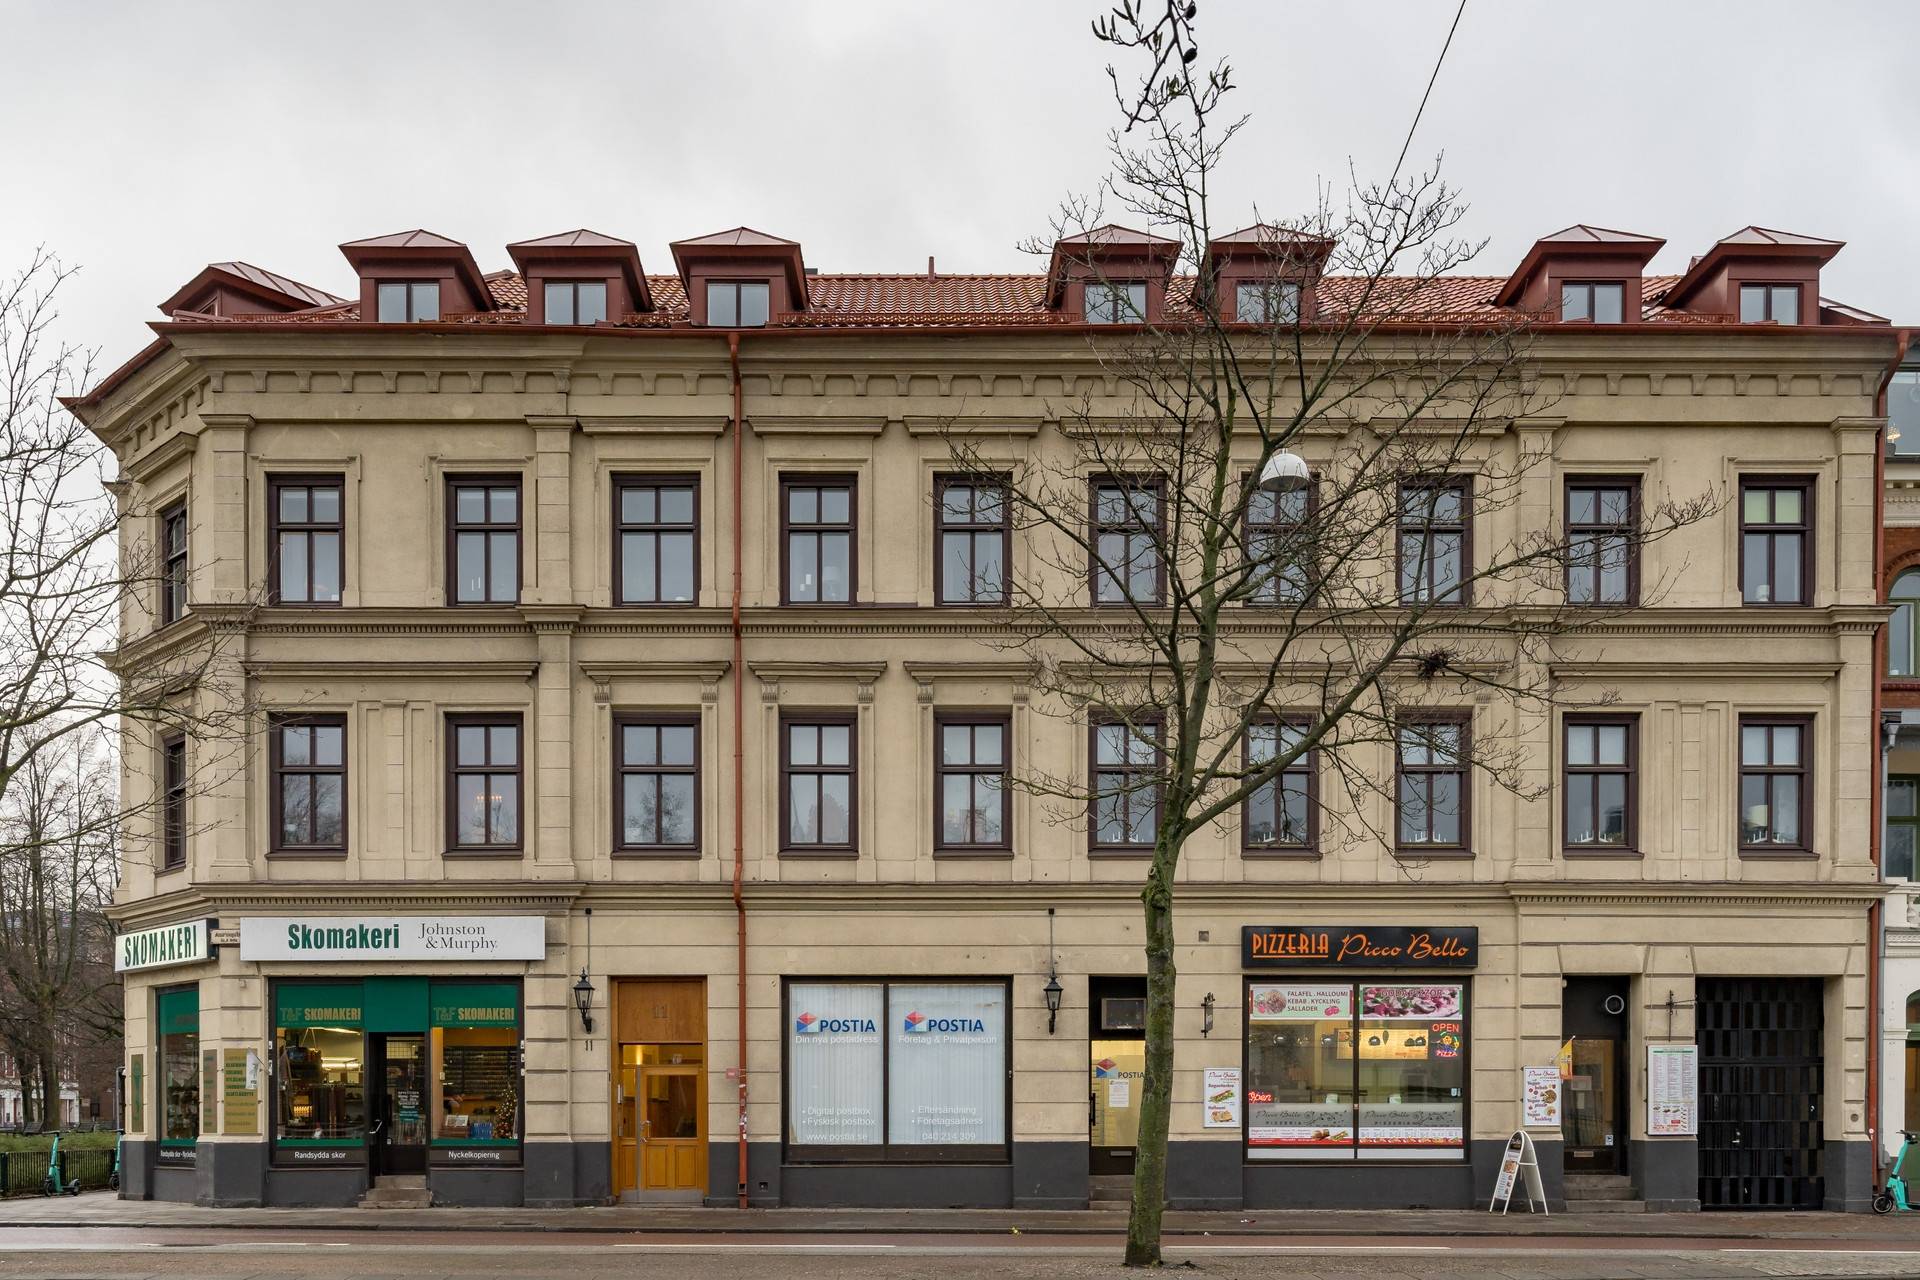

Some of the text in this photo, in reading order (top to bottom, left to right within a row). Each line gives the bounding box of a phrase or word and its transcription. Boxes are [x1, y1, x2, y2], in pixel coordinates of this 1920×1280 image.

[288, 923, 400, 950] Skomakeri
[418, 922, 485, 939] Johnston
[125, 925, 197, 967] SKOMAKERI
[1252, 933, 1469, 961] PIZZERIA Picco Bello
[304, 1007, 361, 1021] SKOMAKERI
[457, 1007, 515, 1021] SKOMAKERI
[820, 1019, 876, 1033] POSTIA
[928, 1019, 984, 1033] POSTIA
[1432, 1023, 1460, 1032] OPEN
[585, 1040, 593, 1052] 11
[795, 1035, 880, 1045] Din nya postadress
[899, 1034, 932, 1046] Företag
[943, 1034, 997, 1046] Privatperson
[1117, 1071, 1144, 1079] POSTIA
[1248, 1091, 1272, 1103] Open
[807, 1105, 872, 1116] Digital postbox
[842, 1117, 875, 1127] postbox
[294, 1151, 346, 1160] Randsydda skor
[448, 1151, 500, 1160] Nyckelkopiering
